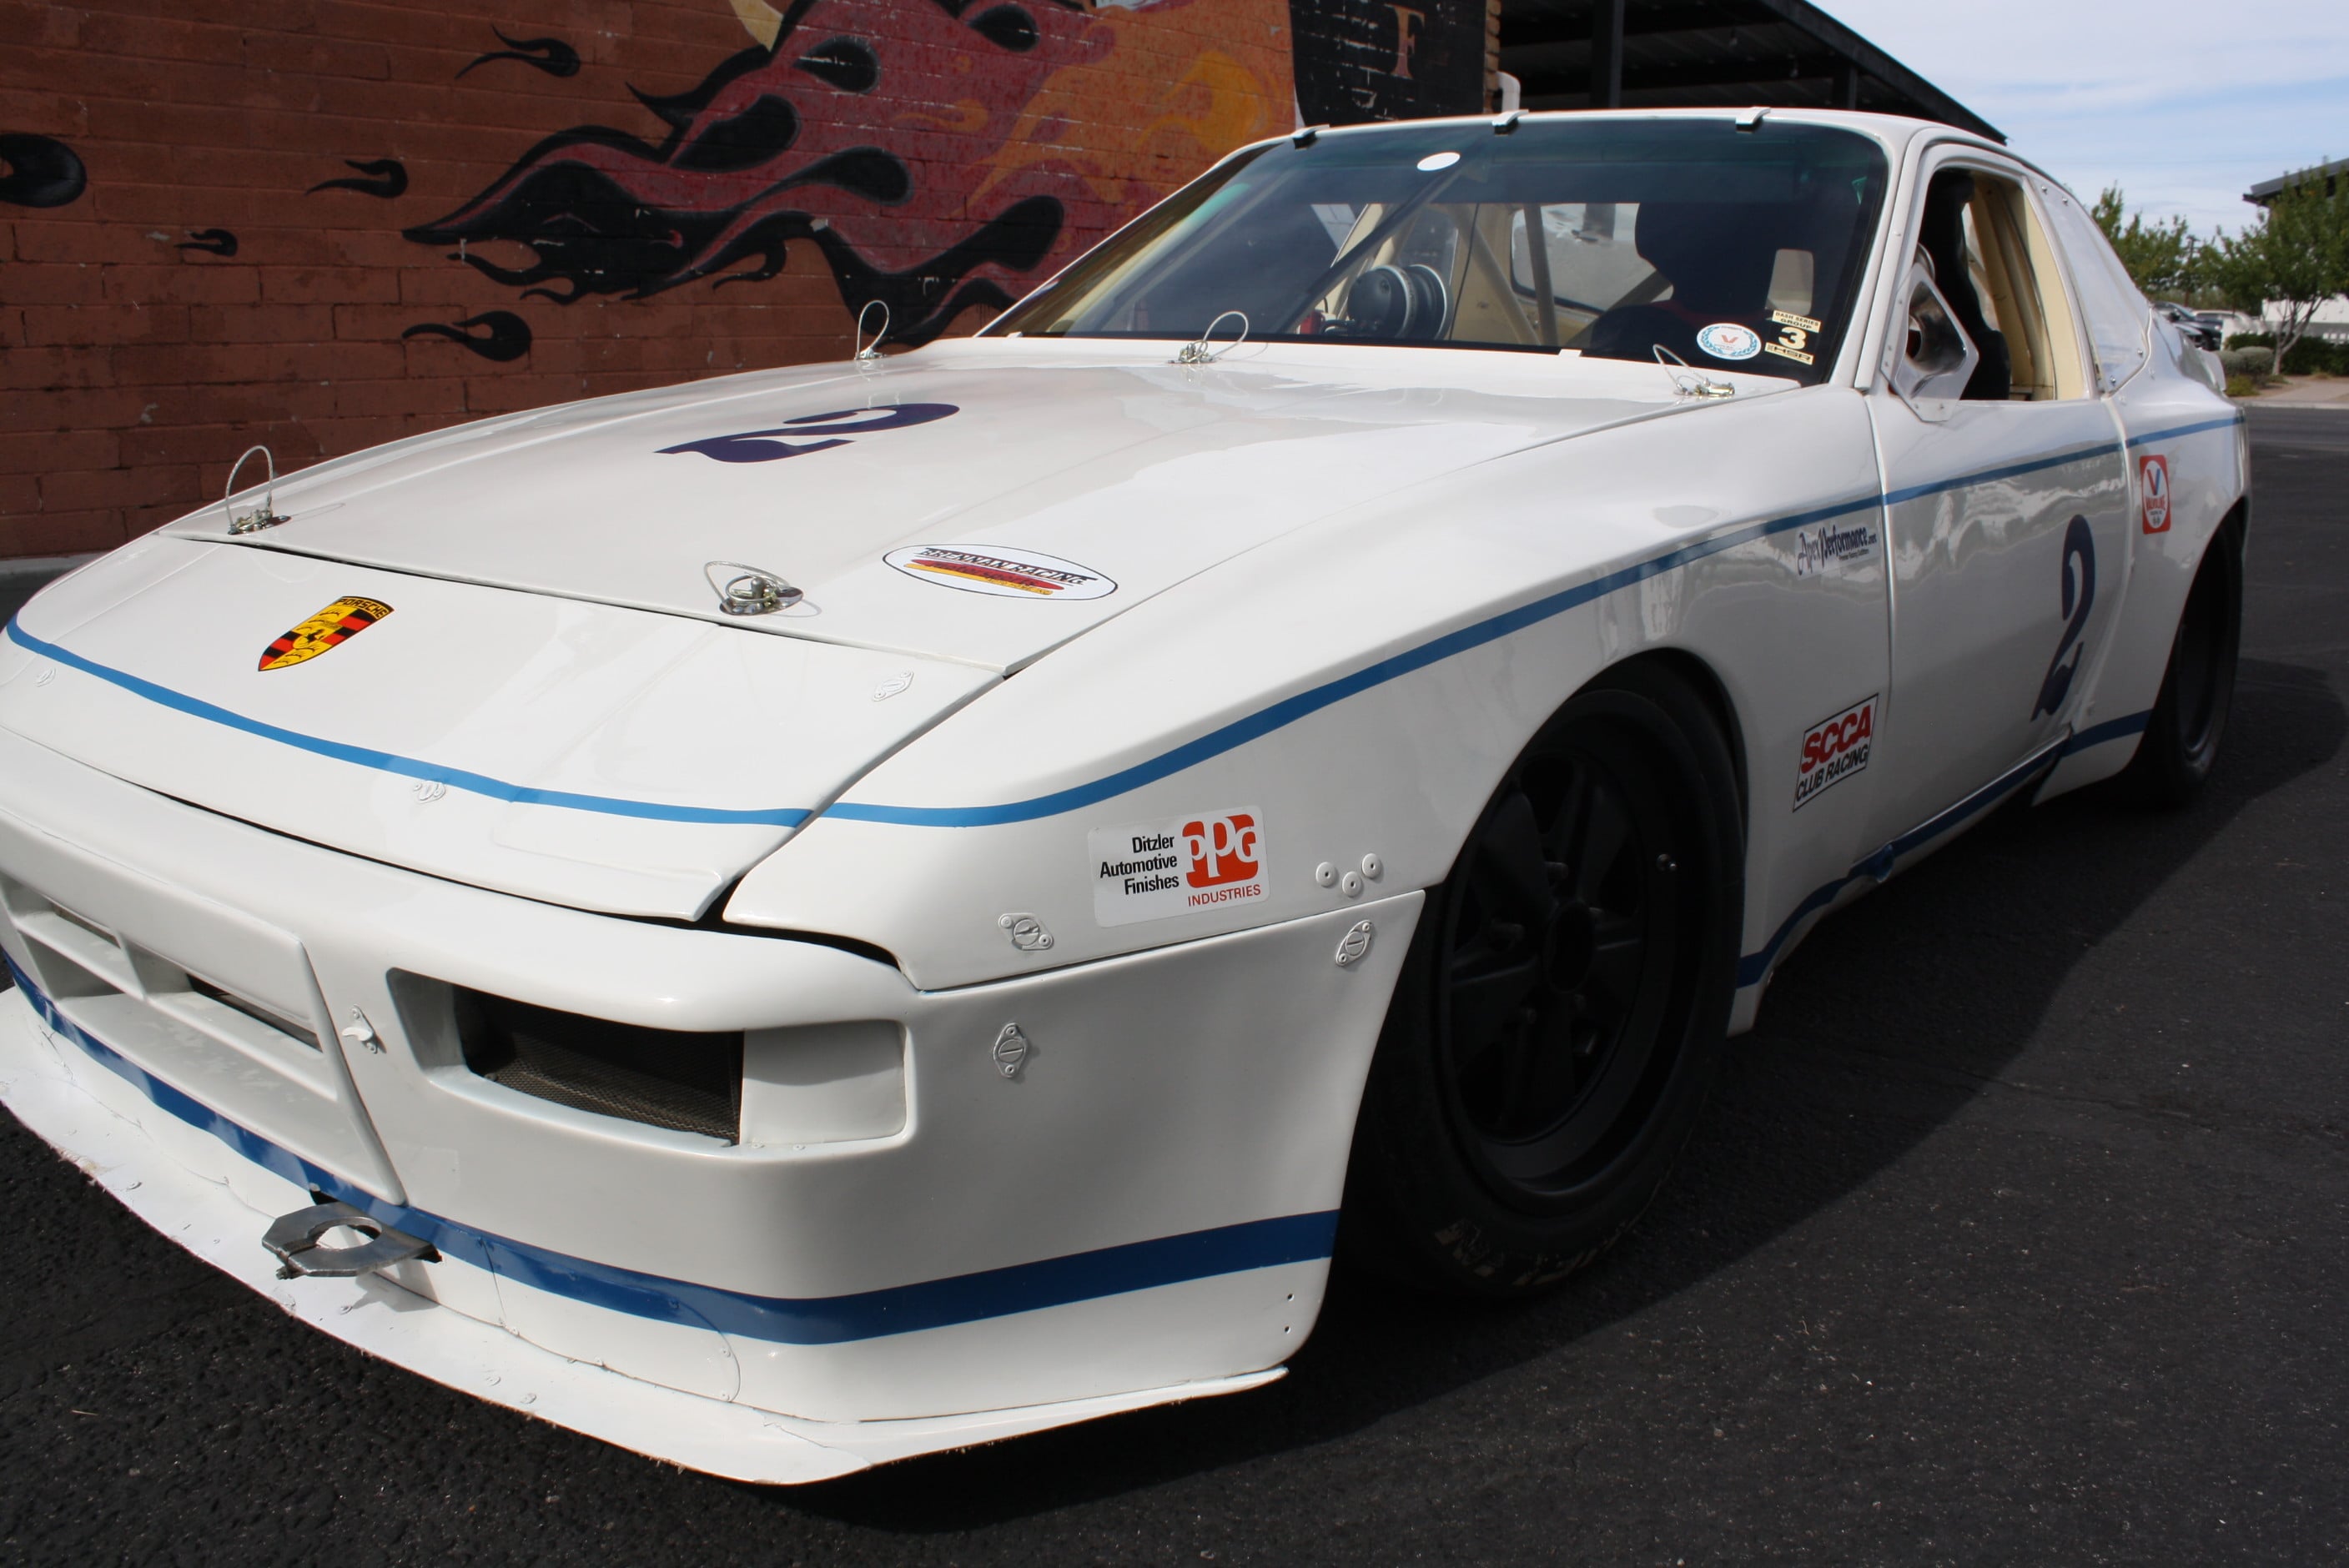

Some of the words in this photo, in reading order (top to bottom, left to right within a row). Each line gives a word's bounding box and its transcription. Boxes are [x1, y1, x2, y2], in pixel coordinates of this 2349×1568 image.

[1780, 318, 1813, 329] GROUP
[1795, 316, 1819, 327] SERIES
[1778, 326, 1807, 349] 3
[653, 403, 960, 463] 2
[920, 548, 1009, 571] BRENNAN
[1008, 563, 1087, 585] RACING
[337, 598, 389, 617] PORSCHE
[2030, 514, 2096, 722] 2
[1801, 705, 1871, 774] SCCA
[1796, 767, 1825, 802] CLUB
[1824, 744, 1869, 782] RACING
[1132, 833, 1175, 853] Ditzler
[1099, 853, 1178, 878] Automotive
[1124, 874, 1180, 896] Finishes
[1187, 883, 1261, 907] INDUSTRIES
